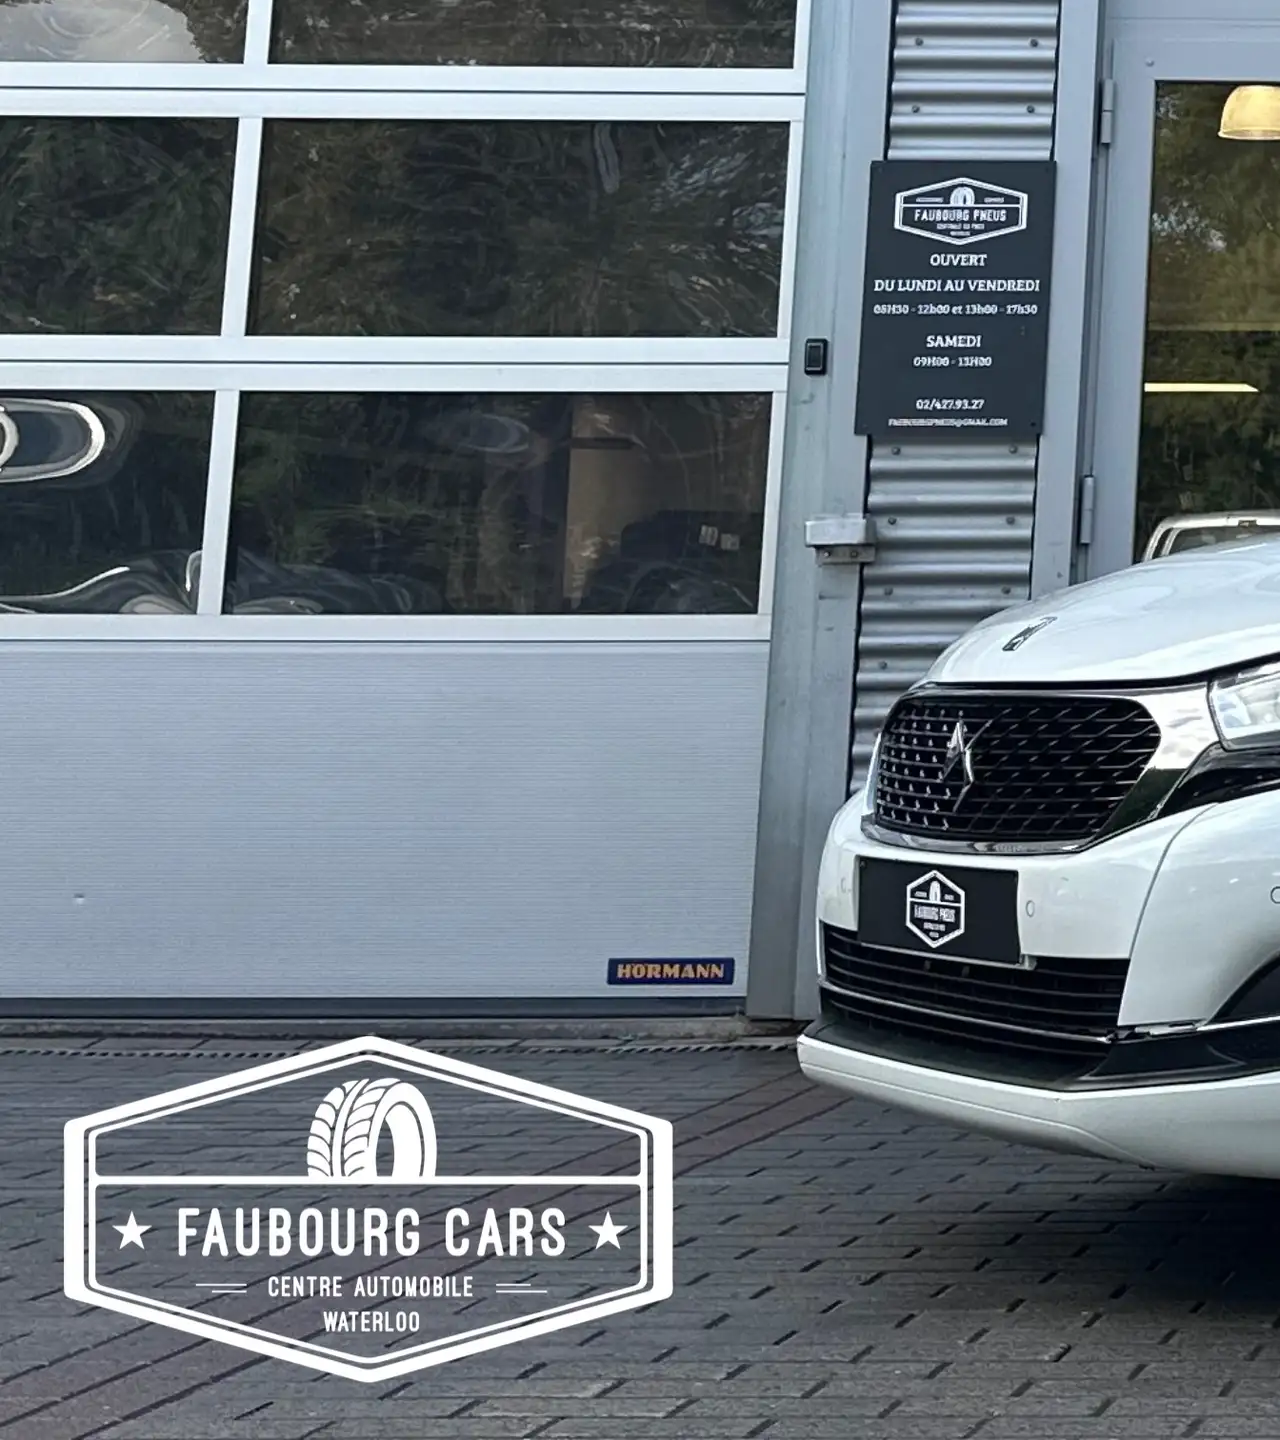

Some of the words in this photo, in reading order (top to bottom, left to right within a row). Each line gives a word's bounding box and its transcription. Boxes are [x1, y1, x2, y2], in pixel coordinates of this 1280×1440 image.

[929, 253, 988, 267] OUVERT
[873, 279, 895, 292] DU
[897, 279, 942, 292] LUNDI
[943, 279, 966, 292] AU
[967, 279, 1041, 292] VENDREDI
[926, 334, 982, 348] SAMEDI
